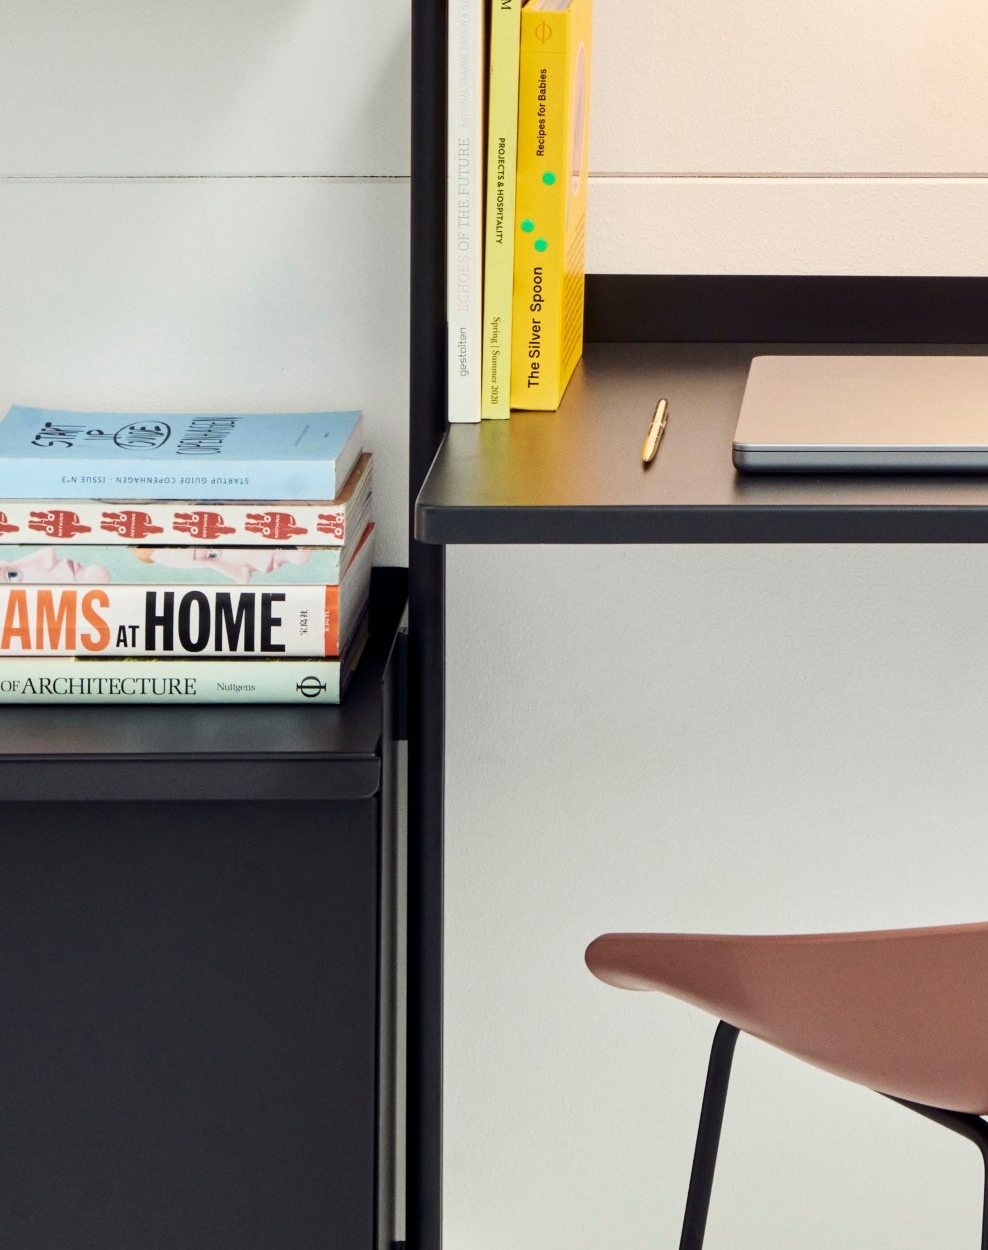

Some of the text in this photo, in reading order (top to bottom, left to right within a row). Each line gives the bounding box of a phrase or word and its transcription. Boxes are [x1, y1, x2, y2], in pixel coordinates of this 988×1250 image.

[536, 68, 547, 156] Recipes for Babies
[497, 137, 506, 180] PROJECTS
[457, 137, 470, 312] ECHOES OF THE FUTURE
[495, 189, 504, 245] HOSPITALITY
[490, 316, 501, 344] Spring
[527, 266, 545, 388] The Silver Spoon
[458, 327, 469, 377] gestalten
[491, 350, 500, 384] Summer
[490, 385, 499, 405] 2020
[116, 476, 176, 484] COPENHAGEN
[210, 477, 249, 485] STARTUP
[116, 625, 140, 648] AT
[144, 591, 287, 653] HOME
[1, 677, 256, 695] OF ARCHITECTURE Nuttgens
